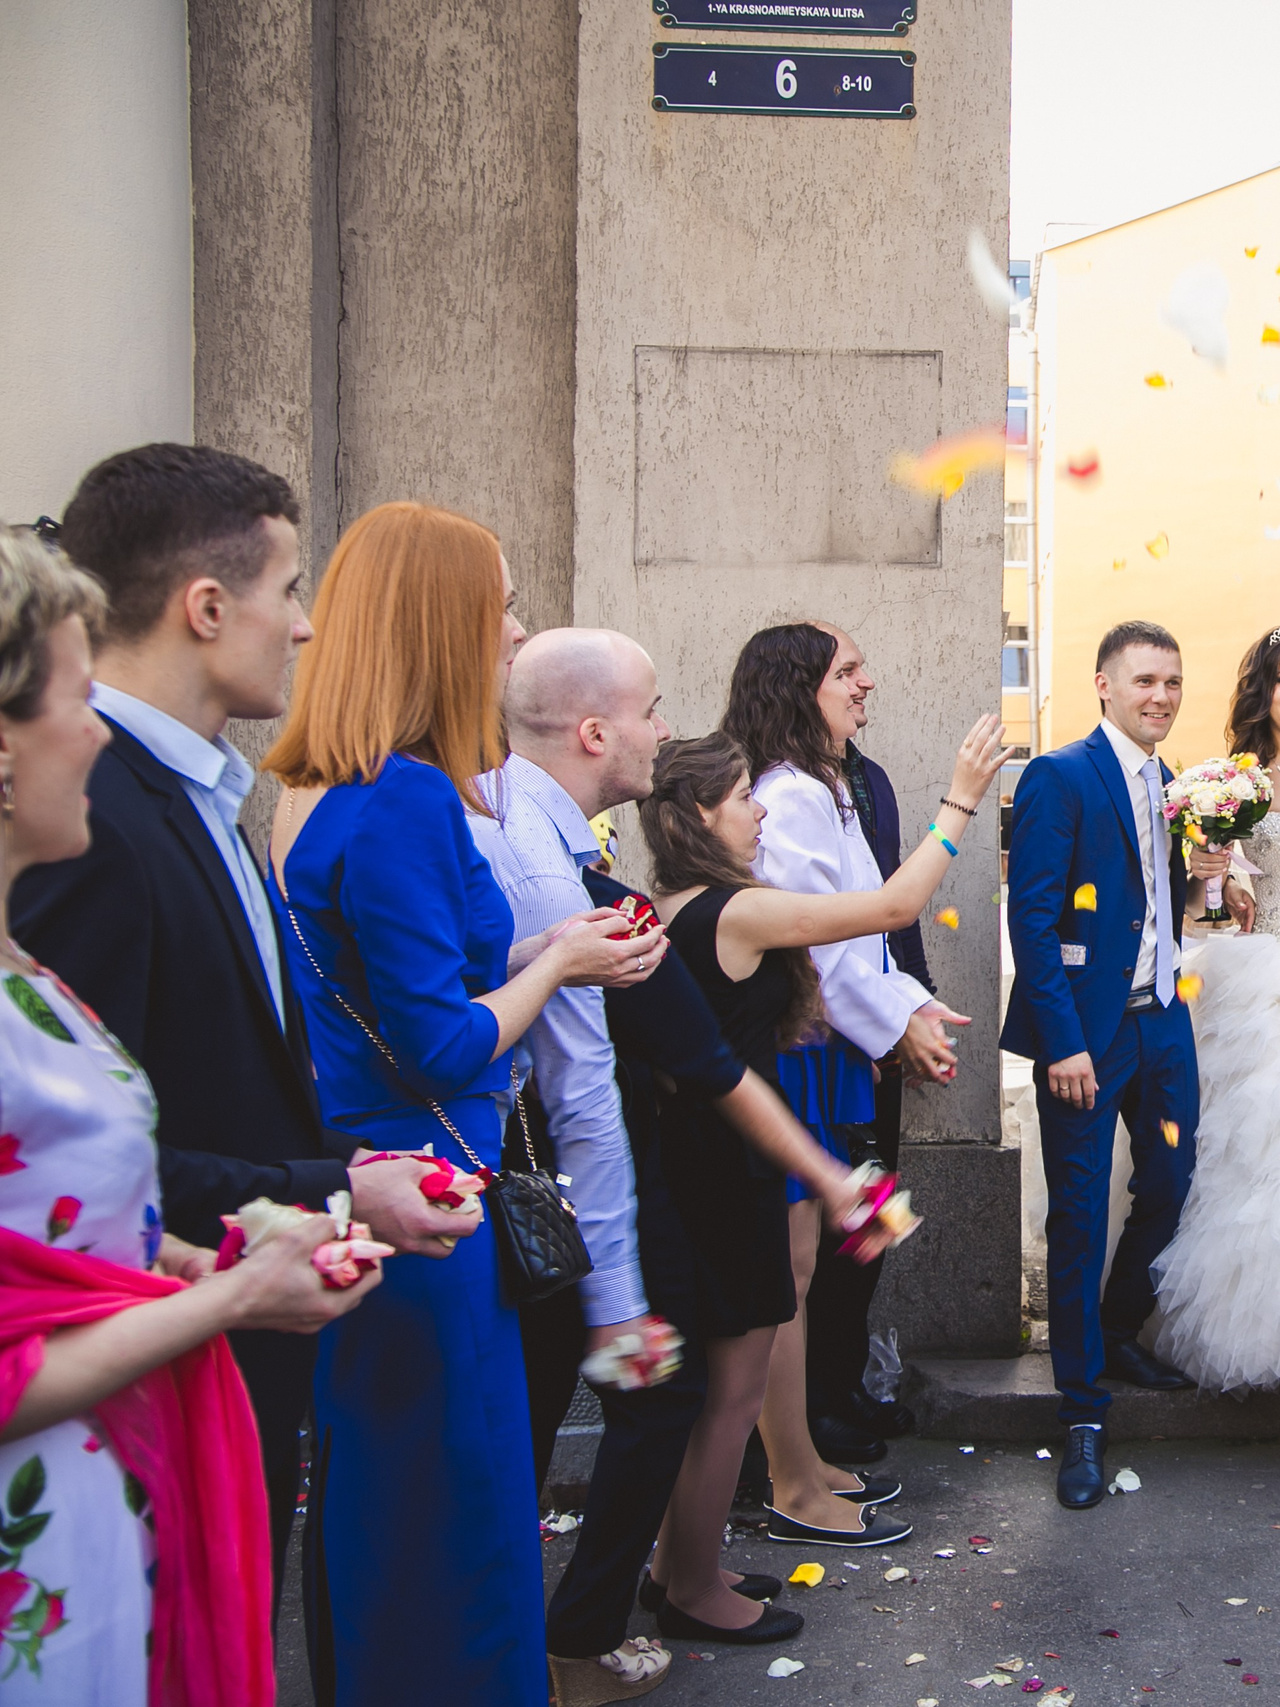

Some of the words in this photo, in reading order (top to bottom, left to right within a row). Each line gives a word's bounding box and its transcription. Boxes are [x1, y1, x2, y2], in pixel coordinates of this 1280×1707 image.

[708, 3, 727, 14] 1-YA
[729, 4, 830, 17] KRASNOARMEYSKAYA
[832, 8, 864, 18] ULITSA
[708, 70, 717, 86] 4
[775, 59, 798, 99] 6
[842, 75, 872, 92] 8-10
